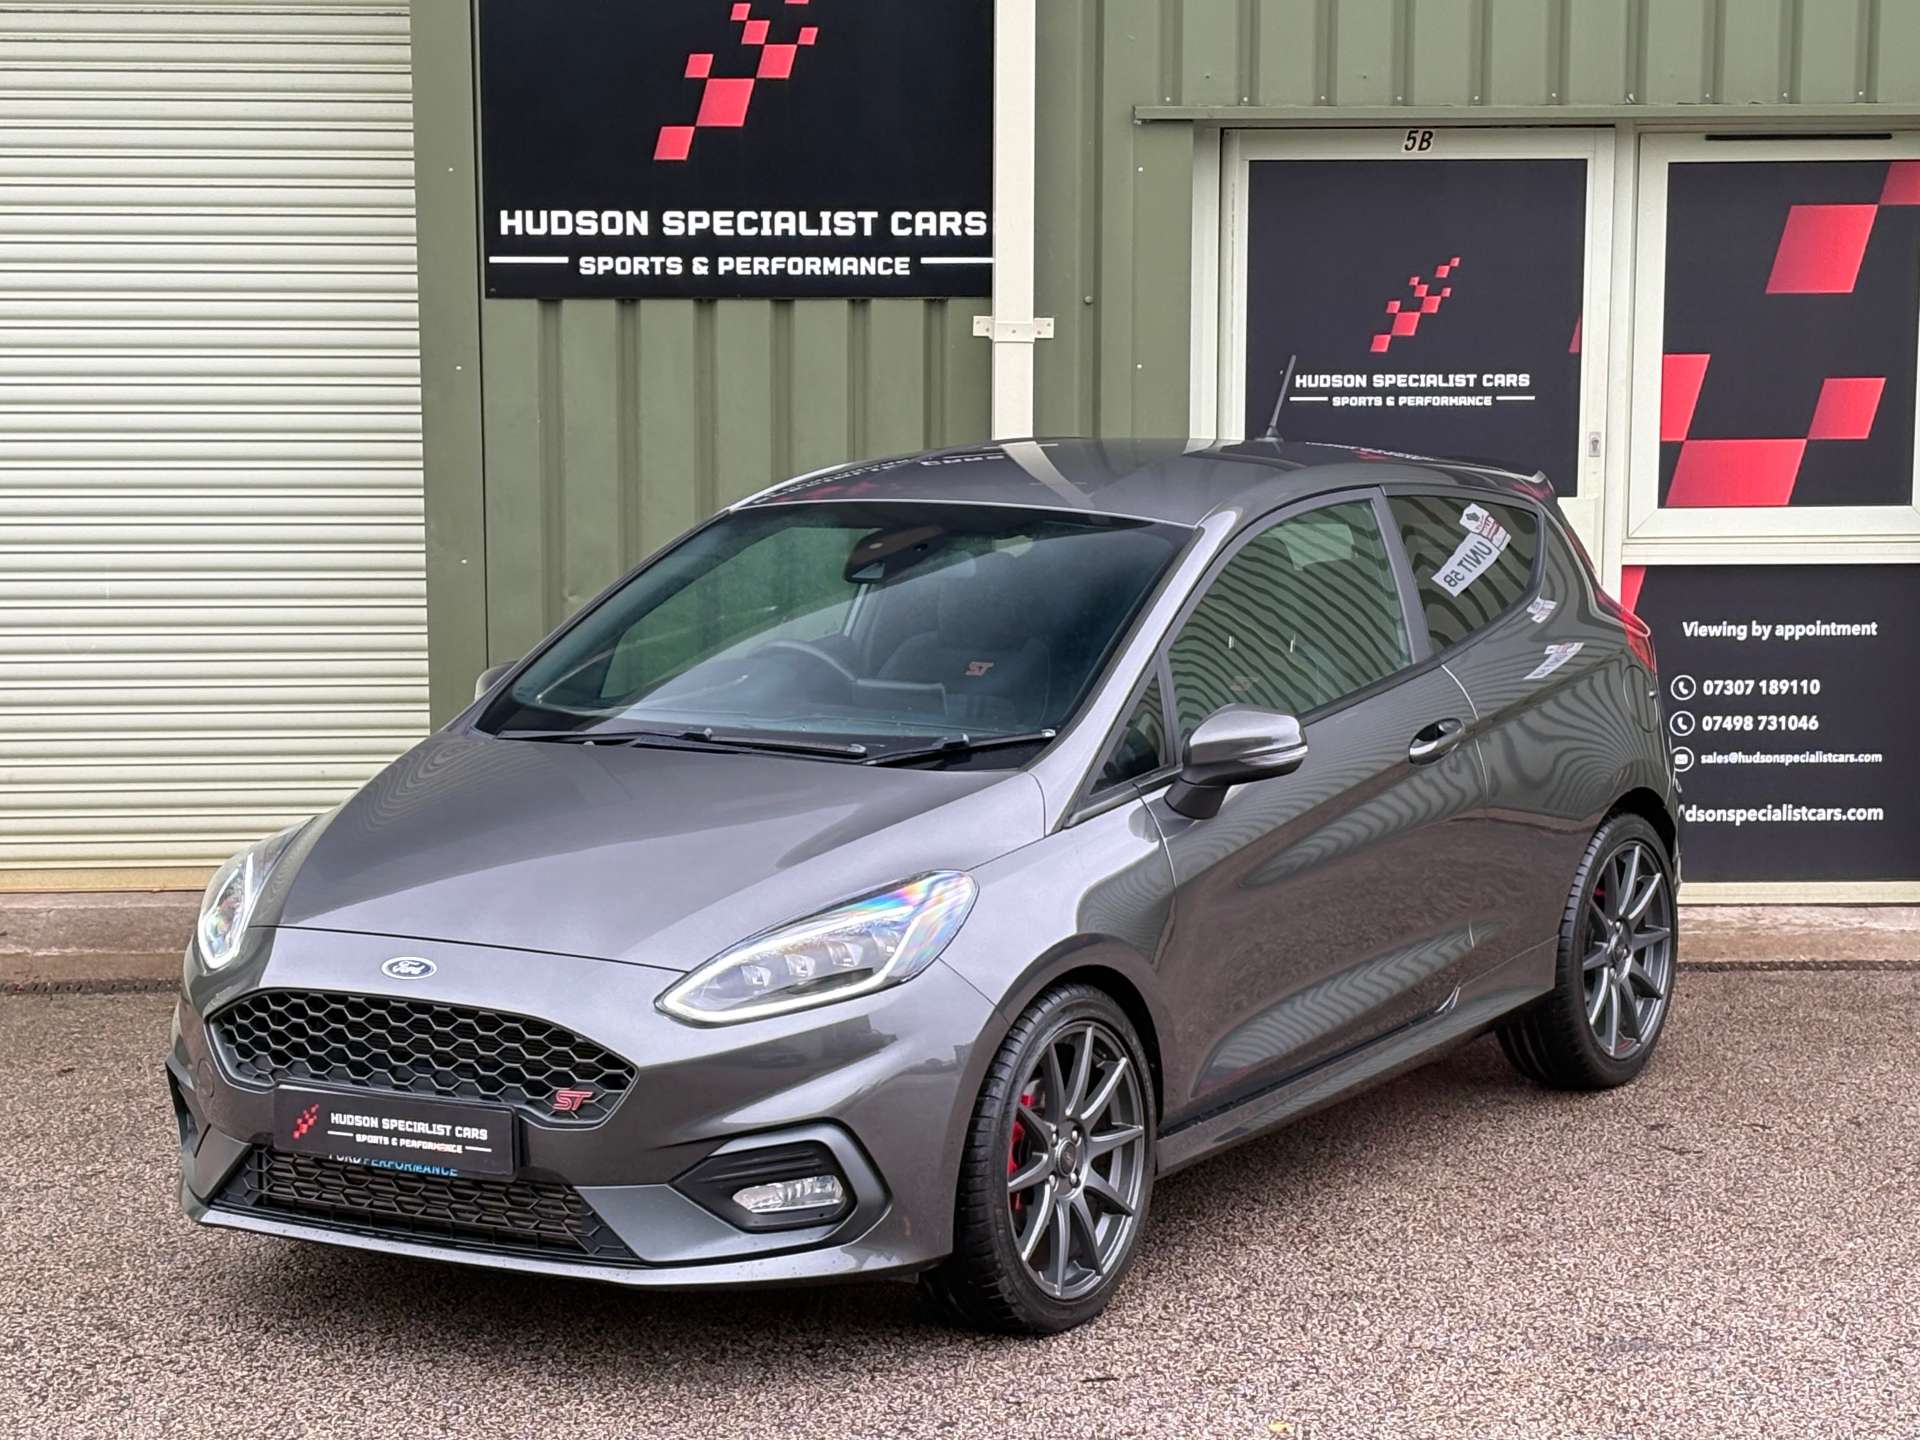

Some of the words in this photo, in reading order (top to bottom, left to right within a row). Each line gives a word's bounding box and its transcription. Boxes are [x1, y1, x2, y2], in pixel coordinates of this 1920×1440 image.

[1404, 129, 1434, 152] 5B
[499, 209, 649, 236] HUDSON
[662, 210, 880, 237] SPECIALIST
[890, 211, 987, 237] CARS
[579, 256, 683, 276] SPORTS
[692, 256, 709, 276] &
[718, 256, 911, 276] PERFORMANCE
[1295, 373, 1368, 388] HUDSON
[1372, 373, 1478, 388] SPECIALIST
[1482, 373, 1531, 388] CARS
[1331, 395, 1383, 407] SPORTS
[1385, 395, 1396, 407] &
[1398, 395, 1493, 407] PERFORMANCE
[1682, 620, 1748, 642] Viewing
[1751, 620, 1772, 641] by
[1774, 620, 1879, 641] appointment
[1702, 679, 1755, 696] 07307
[1758, 678, 1821, 696] 189110
[1701, 714, 1754, 732] 07498
[1757, 714, 1820, 732] 731046
[1700, 750, 1883, 767] sales@hudsonspecialistcars.com
[1684, 804, 1884, 827] dsonspecialistcars.com
[554, 1089, 593, 1112] ST
[330, 1112, 379, 1128] HUDSON
[381, 1118, 453, 1136] SPECIALIST
[454, 1126, 488, 1141] CARS
[355, 1133, 390, 1146] SPORTS
[399, 1138, 463, 1154] PERFORMANCE
